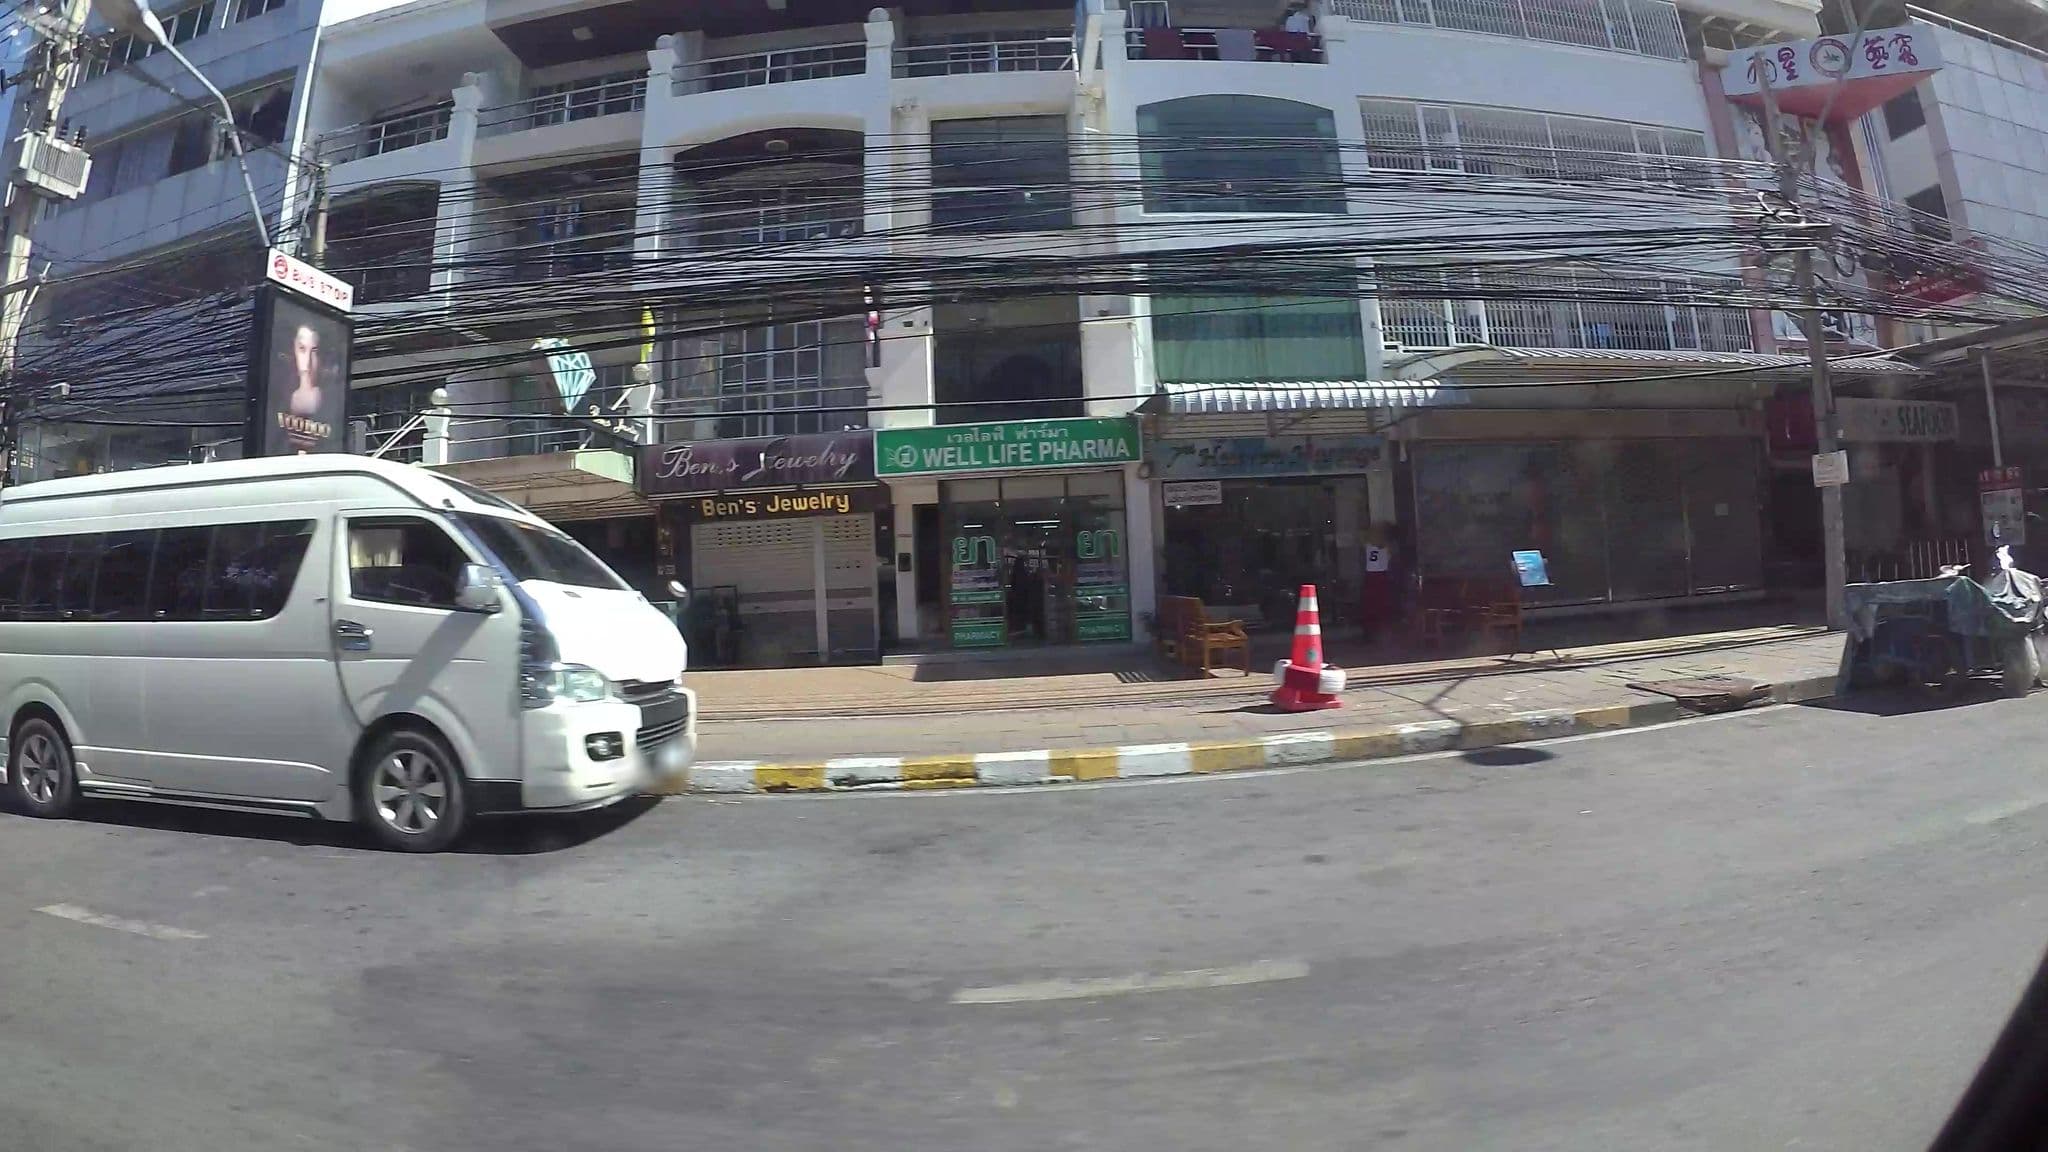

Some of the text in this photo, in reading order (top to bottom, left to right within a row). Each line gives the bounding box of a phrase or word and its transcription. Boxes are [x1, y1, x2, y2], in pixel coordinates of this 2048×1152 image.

[293, 268, 349, 300] BUS STOP
[741, 438, 857, 482] Jewelry
[922, 437, 1131, 468] WELL LIFE PHARMA
[702, 492, 850, 517] Ben's Jewelry
[954, 631, 1000, 641] PHARMACY
